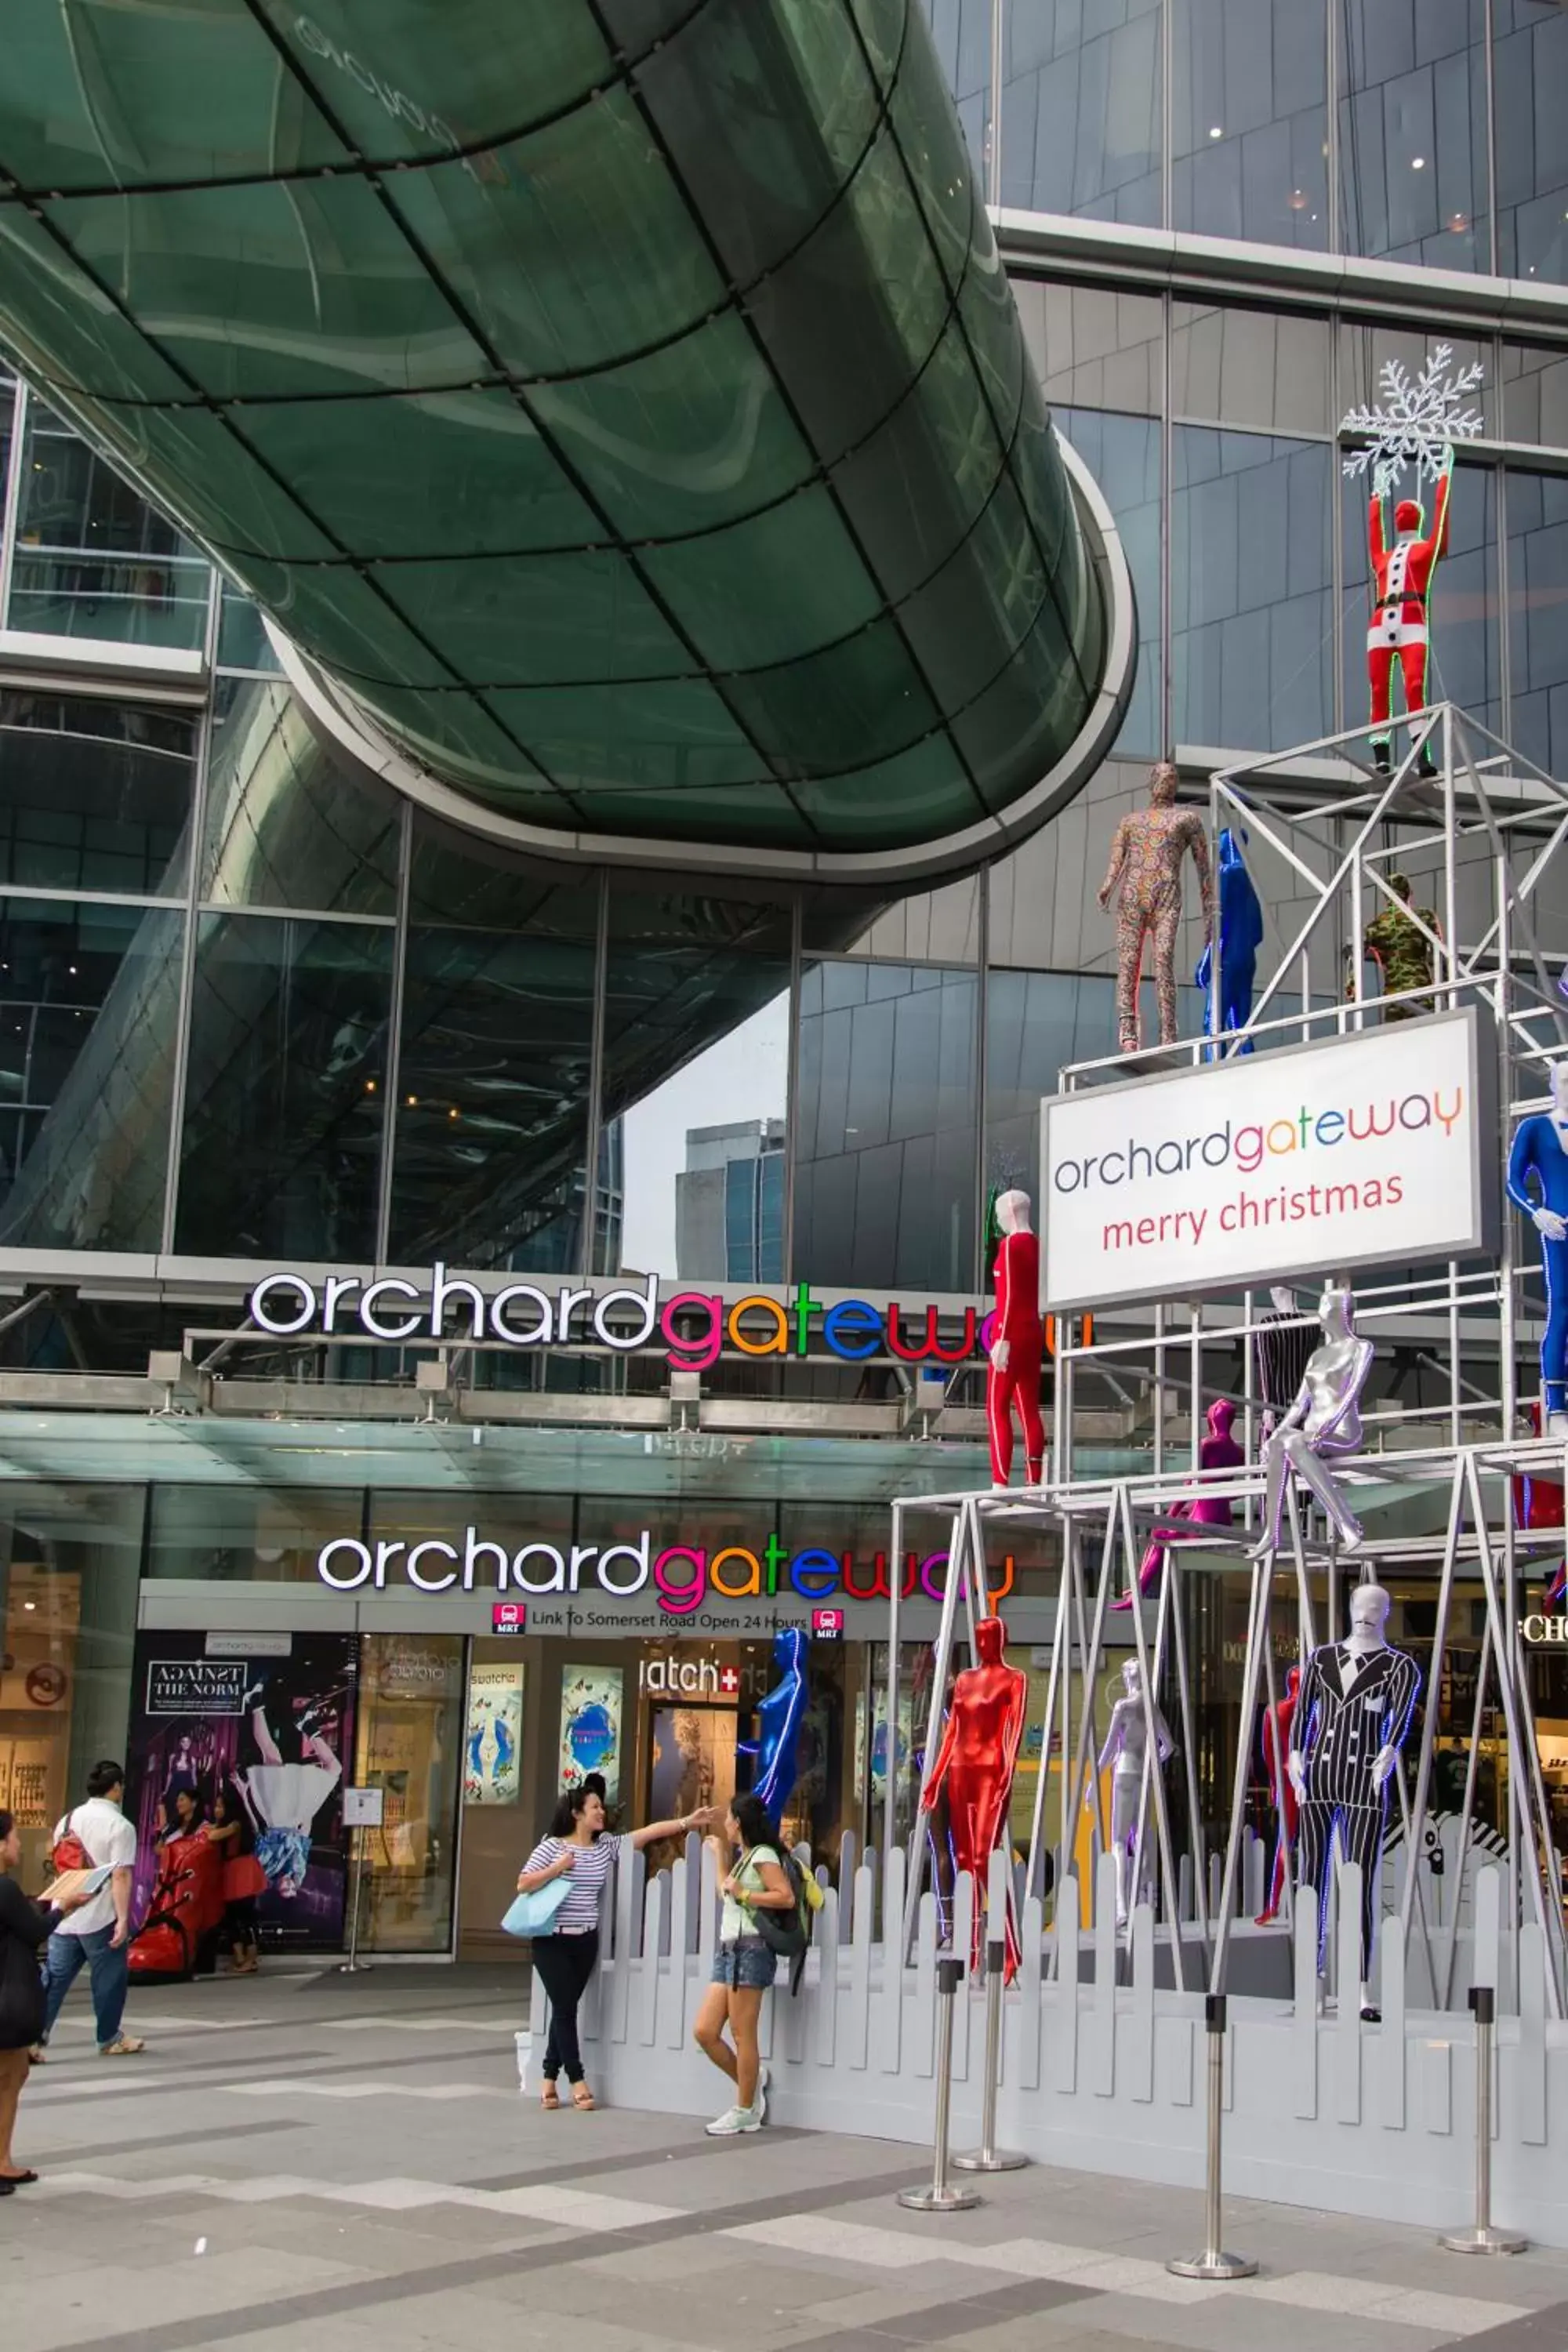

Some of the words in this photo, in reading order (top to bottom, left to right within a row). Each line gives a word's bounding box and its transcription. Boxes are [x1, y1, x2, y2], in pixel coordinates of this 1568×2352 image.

[1054, 1087, 1462, 1193] orchardgateway
[1102, 1207, 1207, 1250] merry
[1219, 1174, 1403, 1232] christmas
[249, 1261, 1094, 1372] orchardgatewy
[496, 1624, 520, 1633] MRT
[532, 1611, 563, 1625] Link
[567, 1611, 583, 1625] To
[586, 1612, 655, 1627] Somerset
[659, 1614, 695, 1627] Road
[700, 1614, 739, 1630] Open
[743, 1616, 760, 1628] 24
[764, 1616, 806, 1629] Hours
[815, 1629, 838, 1639] MRT
[157, 1667, 242, 1682] AGAINST
[154, 1682, 189, 1696] THE
[193, 1683, 240, 1696] NORM
